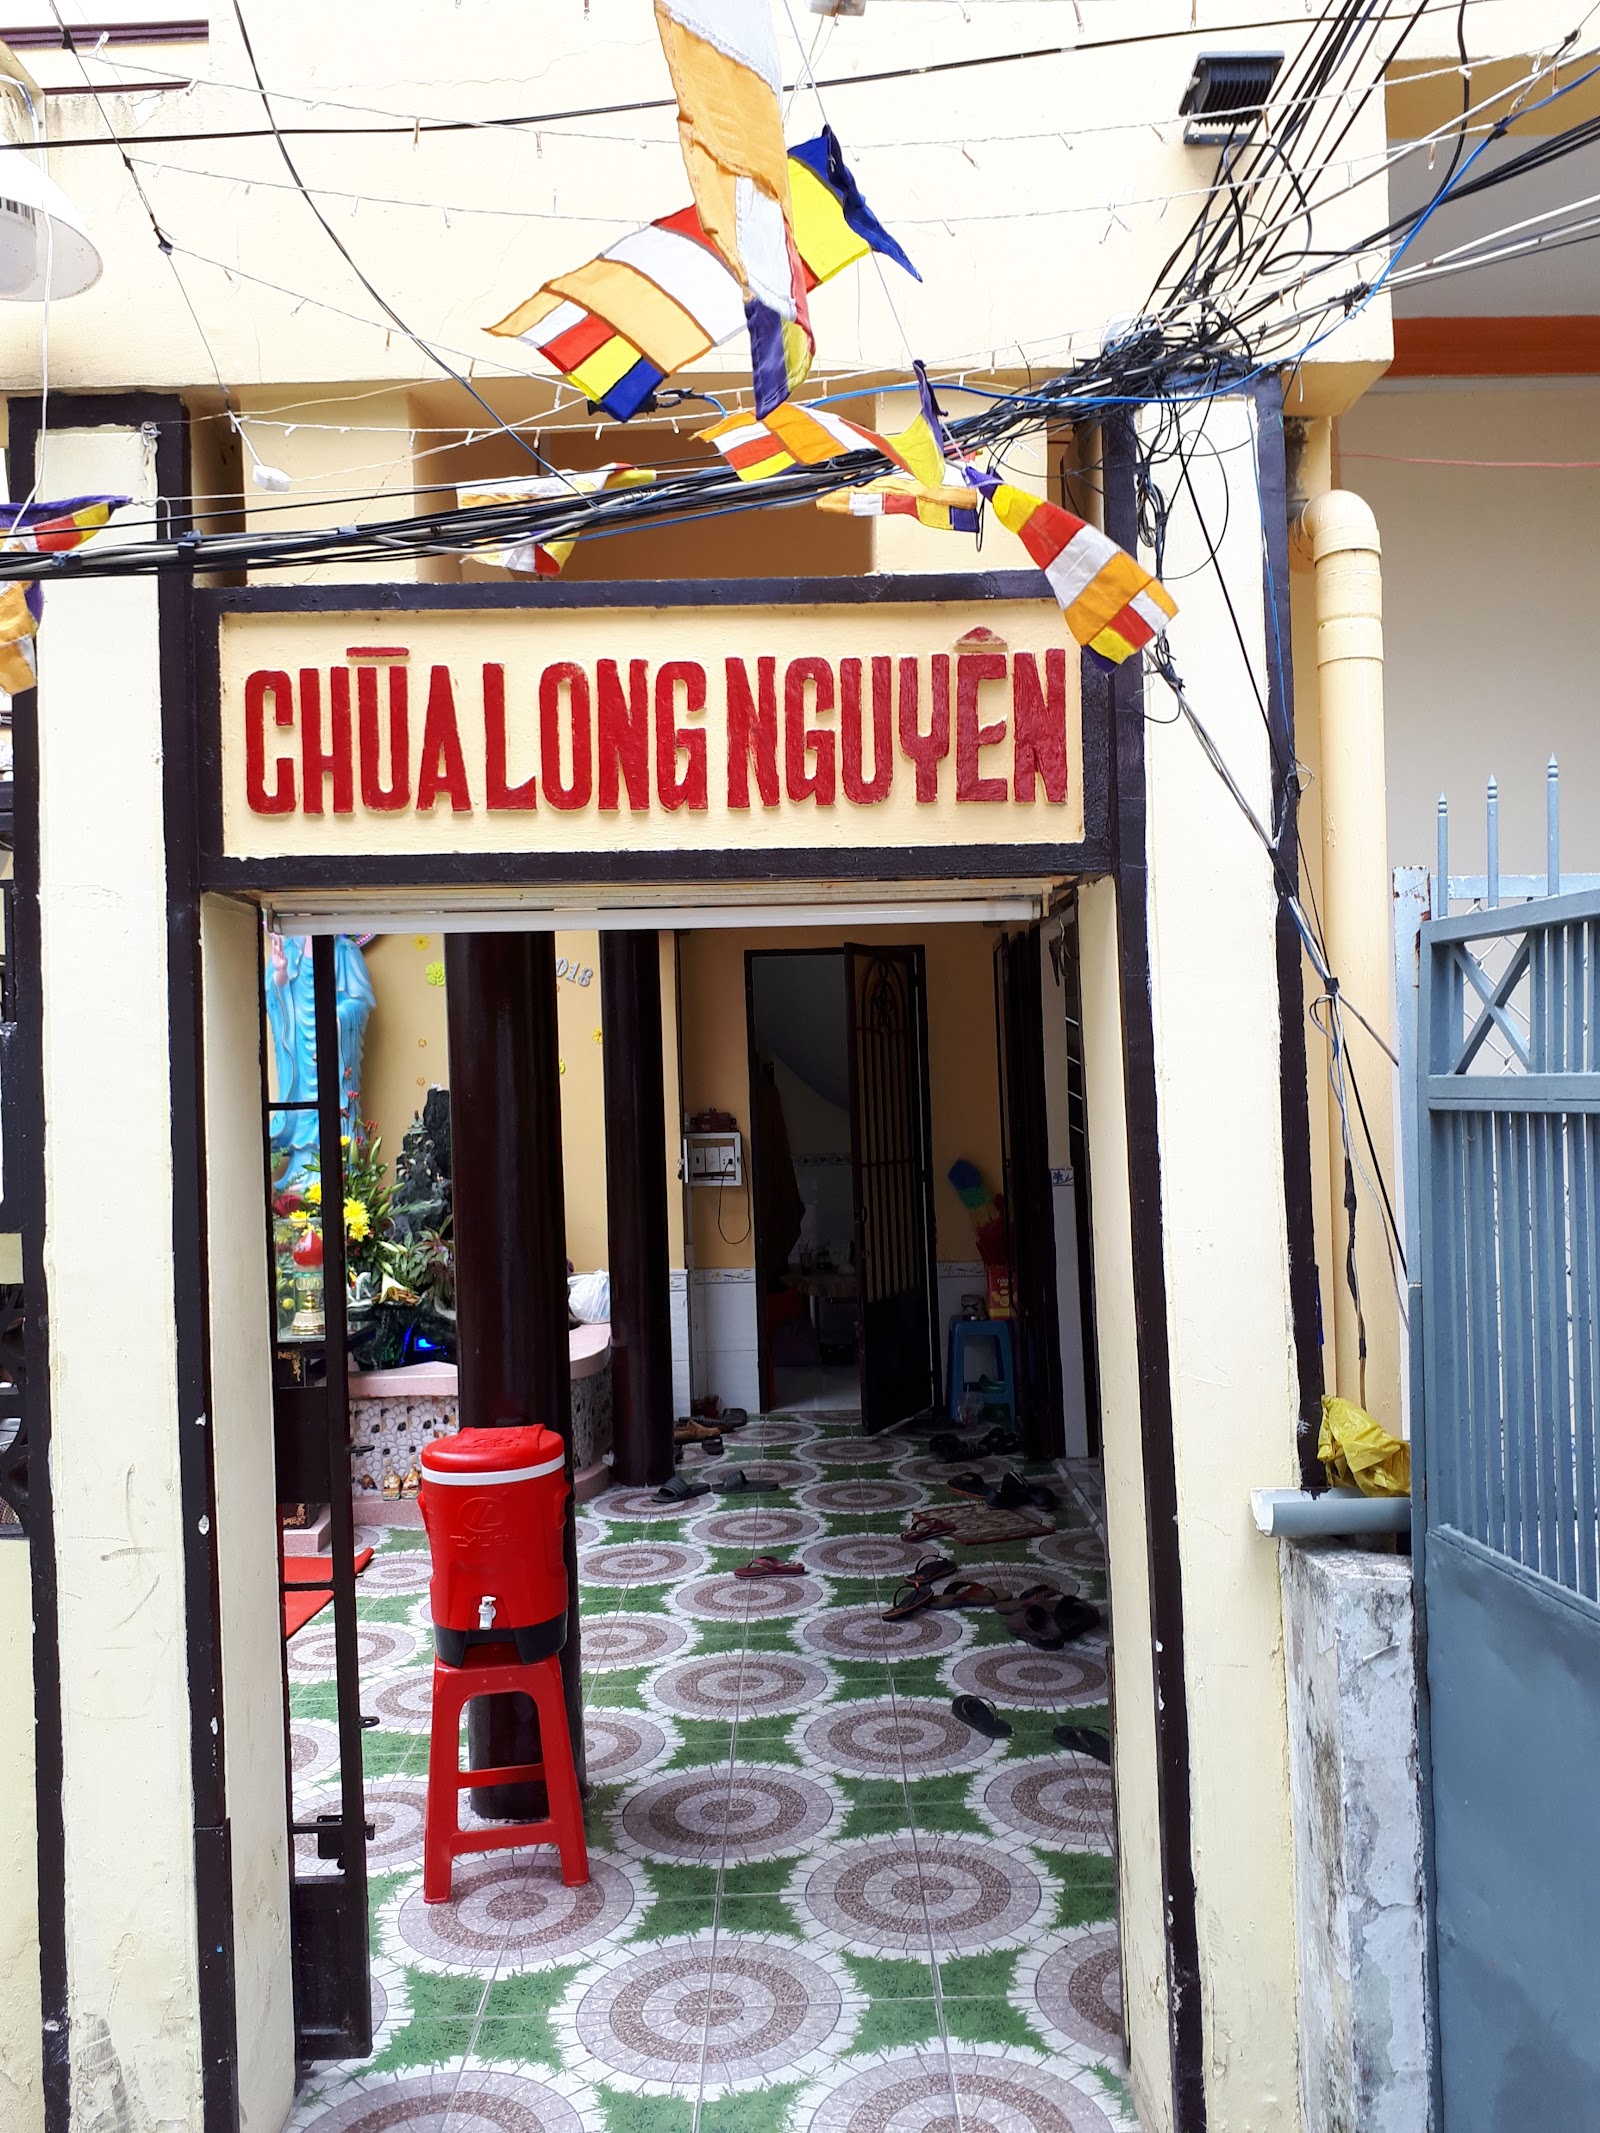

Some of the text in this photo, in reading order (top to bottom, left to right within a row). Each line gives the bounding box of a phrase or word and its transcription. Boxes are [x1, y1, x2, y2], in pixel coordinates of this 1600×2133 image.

[482, 658, 708, 813] LONG
[725, 625, 1068, 810] NGUYÊN
[556, 957, 593, 987] 018
